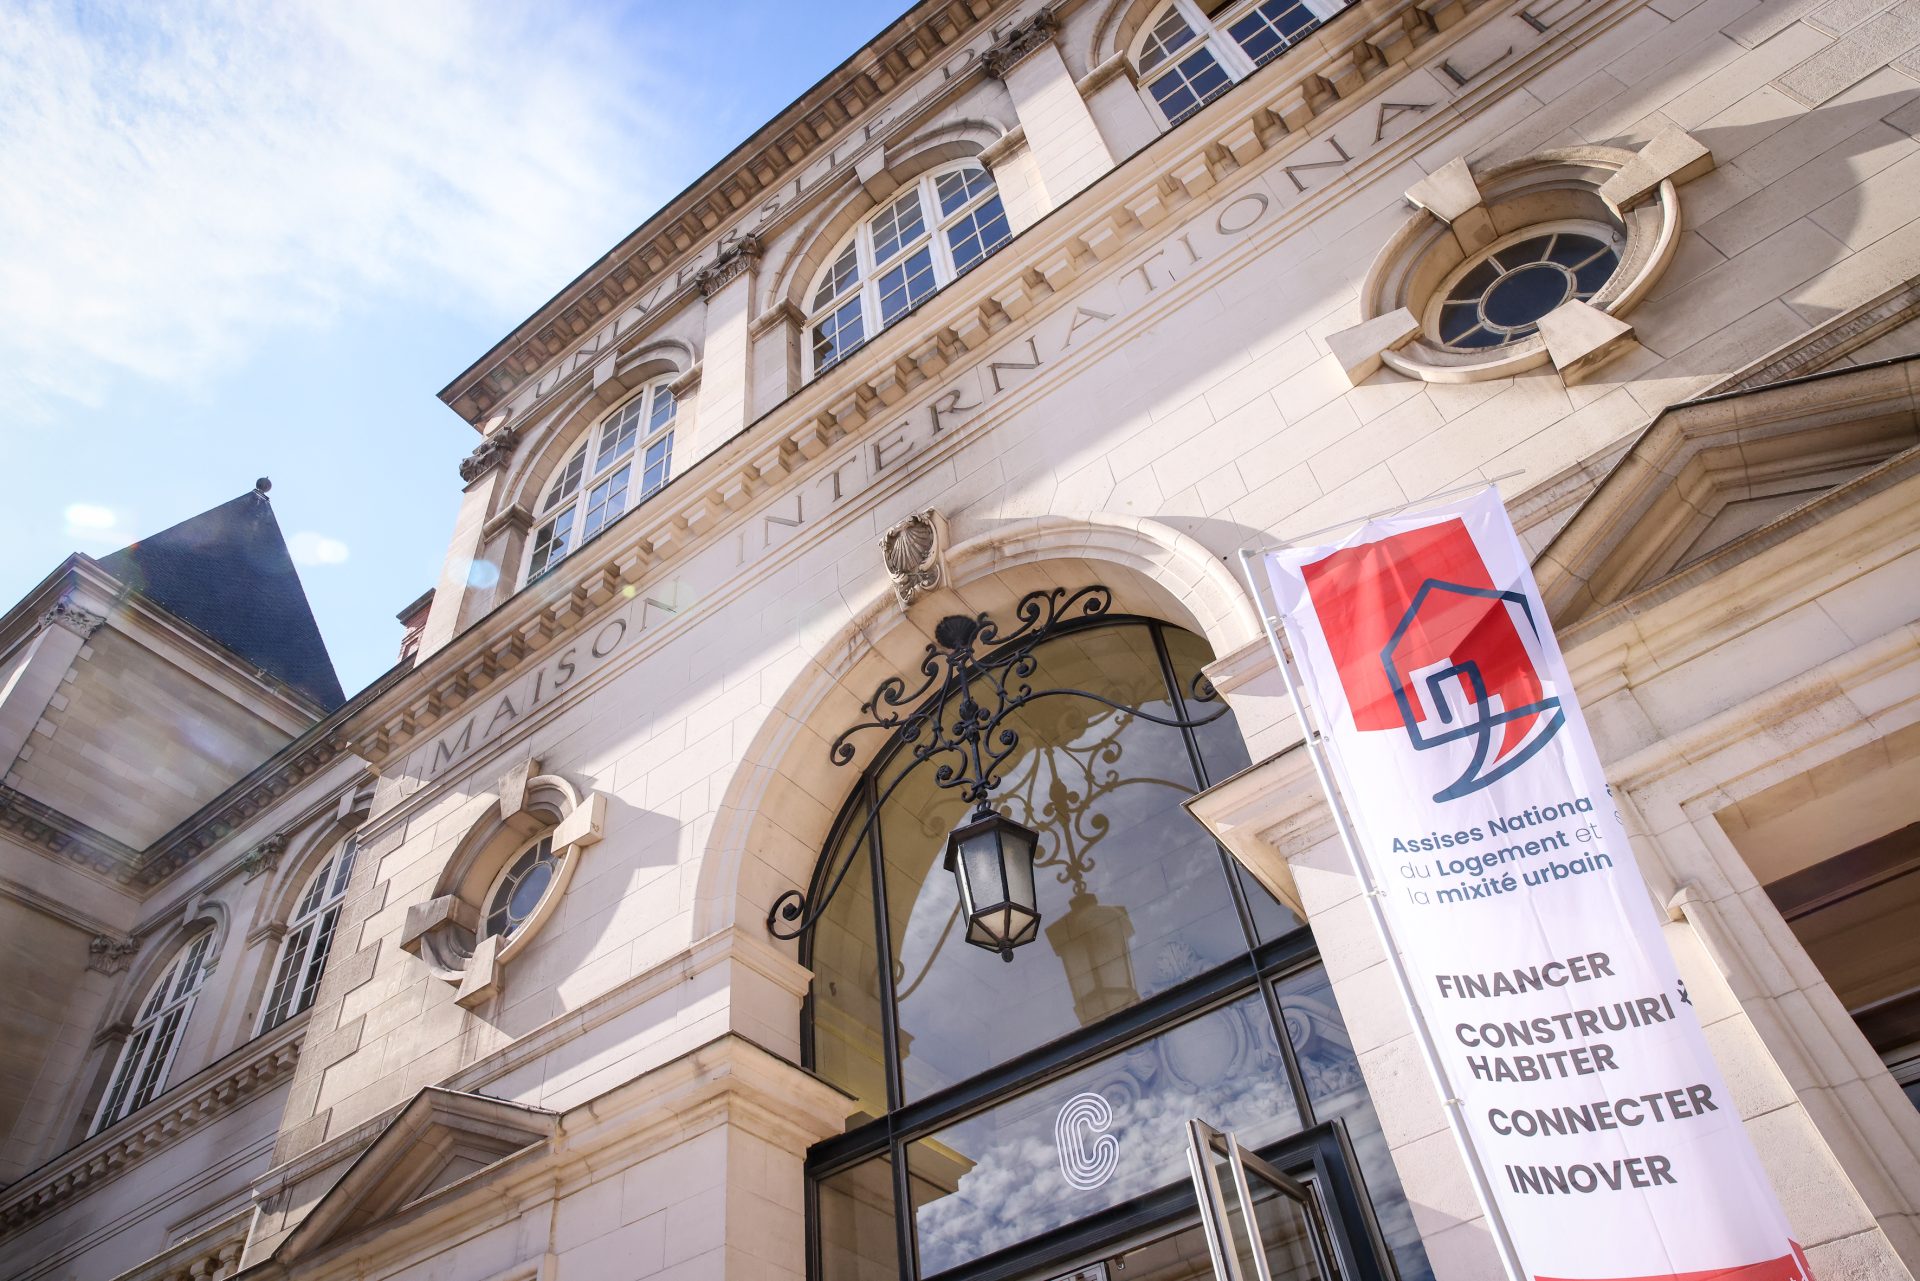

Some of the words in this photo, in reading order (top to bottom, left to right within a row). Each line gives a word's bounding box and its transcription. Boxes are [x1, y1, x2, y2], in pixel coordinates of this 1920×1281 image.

[430, 575, 681, 774] MAISON
[736, 0, 1592, 567] INTERNATIONALE
[1392, 824, 1484, 853] Assises
[1487, 796, 1593, 837] Nationa
[1400, 862, 1431, 879] du
[1435, 829, 1570, 880] Logement
[1575, 822, 1602, 842] et
[1408, 887, 1430, 905] la
[1436, 872, 1518, 904] mixité
[1435, 952, 1615, 999] FINANCER
[1466, 1043, 1619, 1083] HABITER
[1487, 1083, 1719, 1137] CONNECTER
[1505, 1154, 1678, 1195] INNOVER
